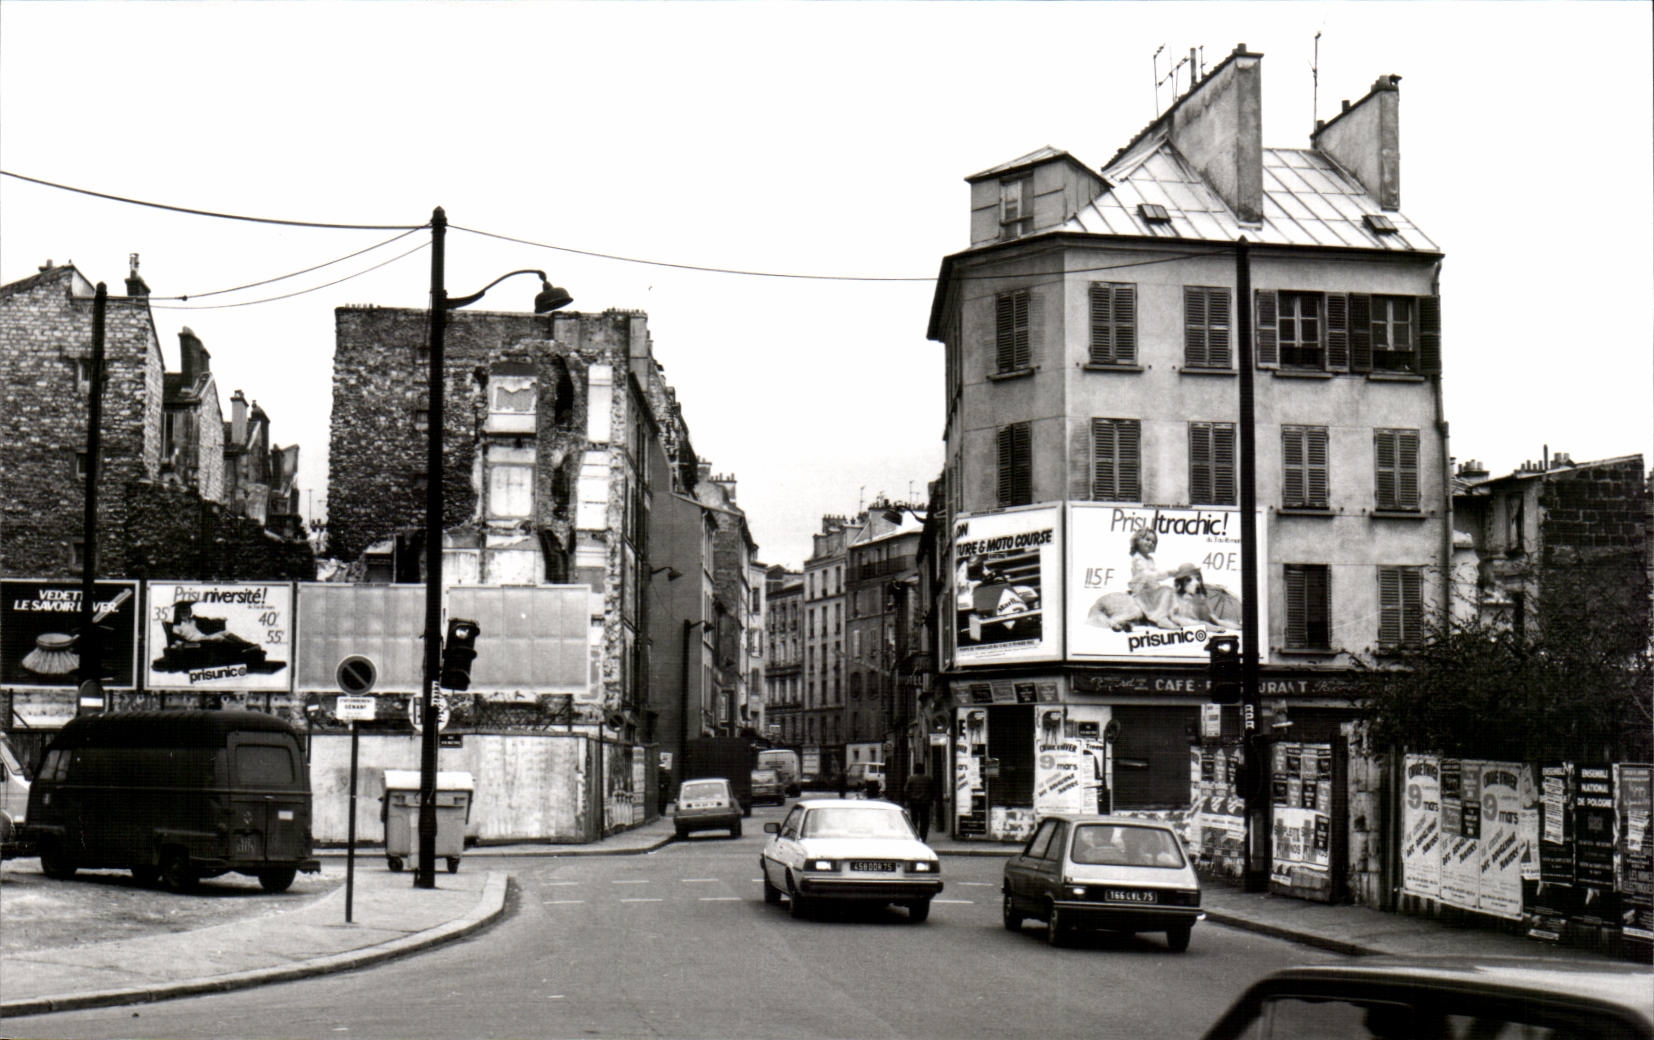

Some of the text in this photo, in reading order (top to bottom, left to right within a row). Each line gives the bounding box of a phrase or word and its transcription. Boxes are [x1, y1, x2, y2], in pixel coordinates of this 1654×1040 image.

[986, 536, 1014, 552] MOTO
[1015, 528, 1053, 548] COURSE
[13, 600, 30, 611] LE
[31, 601, 75, 612] SAVOIR
[1128, 628, 1195, 652] prisunic
[189, 666, 239, 684] prisunic
[1407, 783, 1422, 810] 9
[1482, 793, 1498, 821] 9
